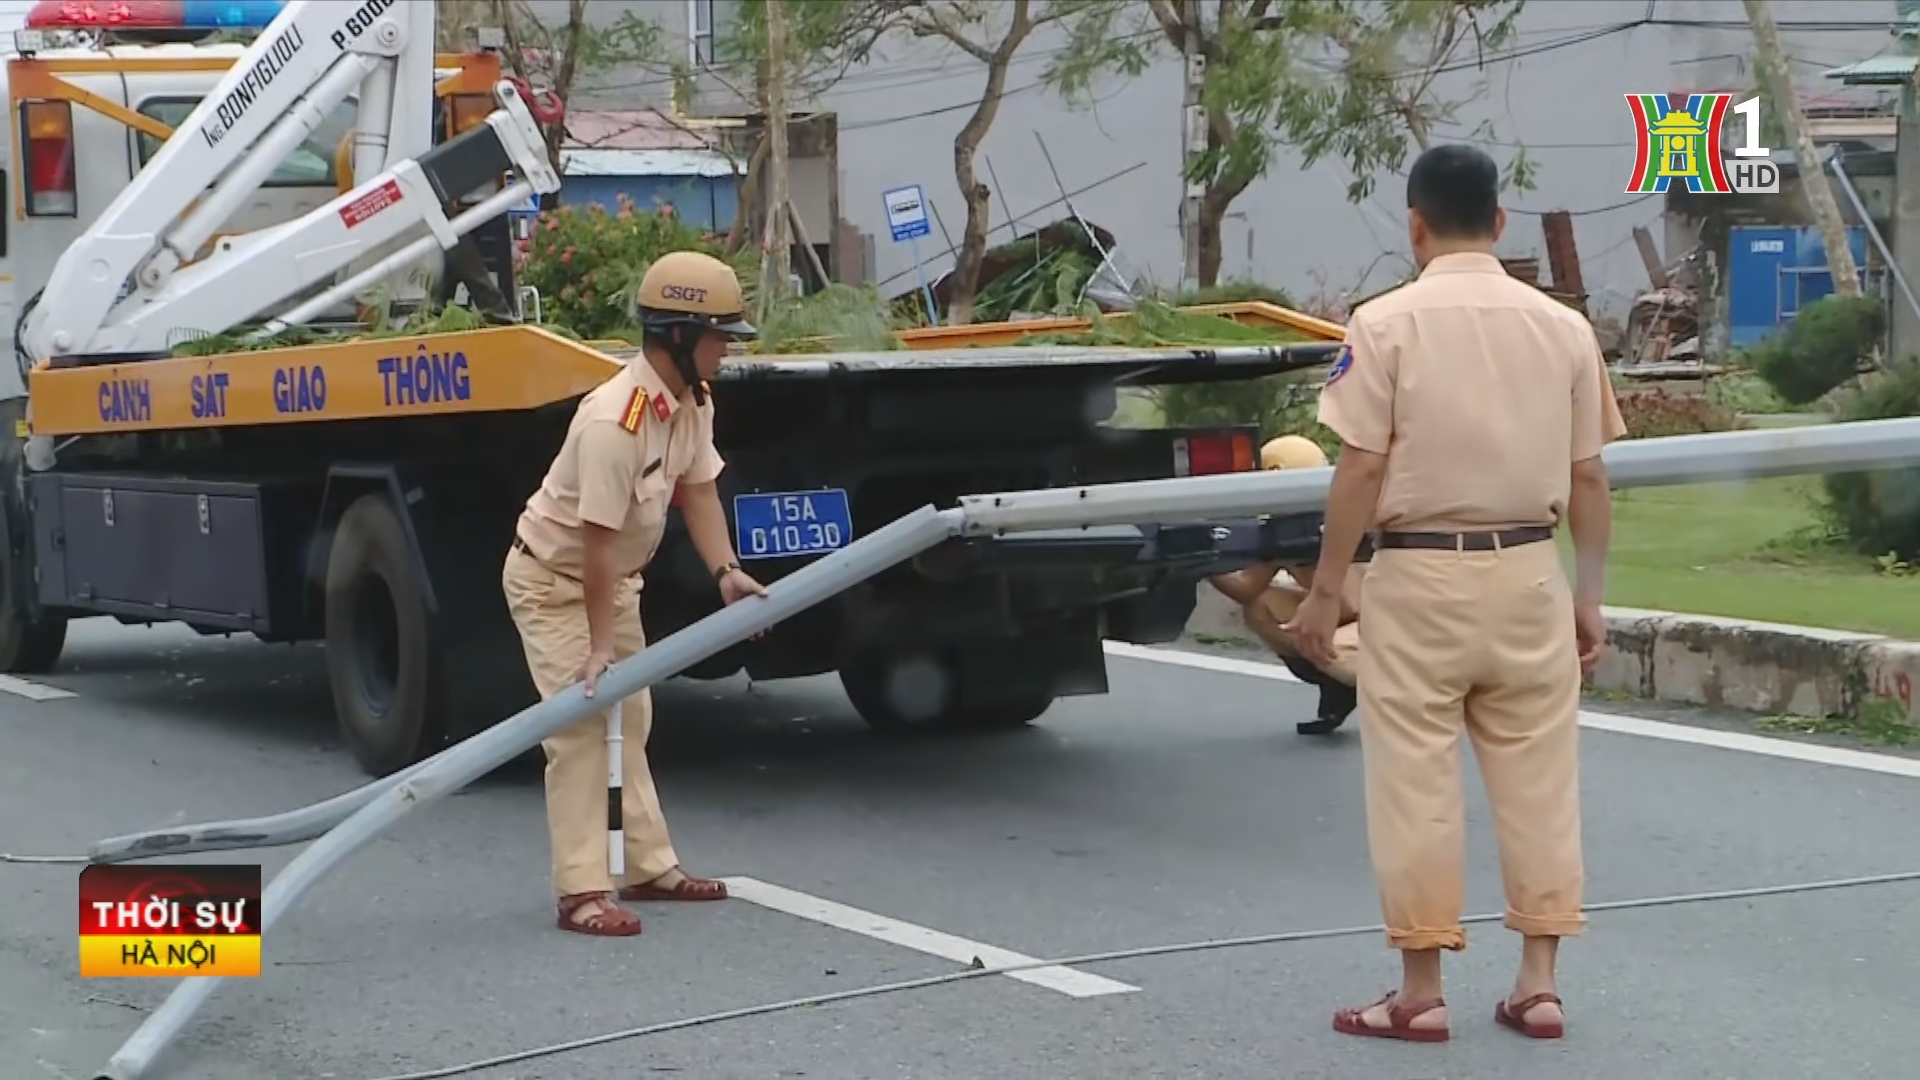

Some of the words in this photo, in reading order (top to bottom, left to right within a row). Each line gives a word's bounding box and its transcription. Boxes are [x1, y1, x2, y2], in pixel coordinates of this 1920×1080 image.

[216, 23, 304, 130] BONFIGLIOLI
[661, 284, 707, 302] CSGT
[191, 360, 229, 417] SÁT
[273, 365, 326, 412] GIAO
[378, 343, 471, 406] THÔNG
[771, 496, 816, 521] 15A
[752, 522, 840, 553] 010.30
